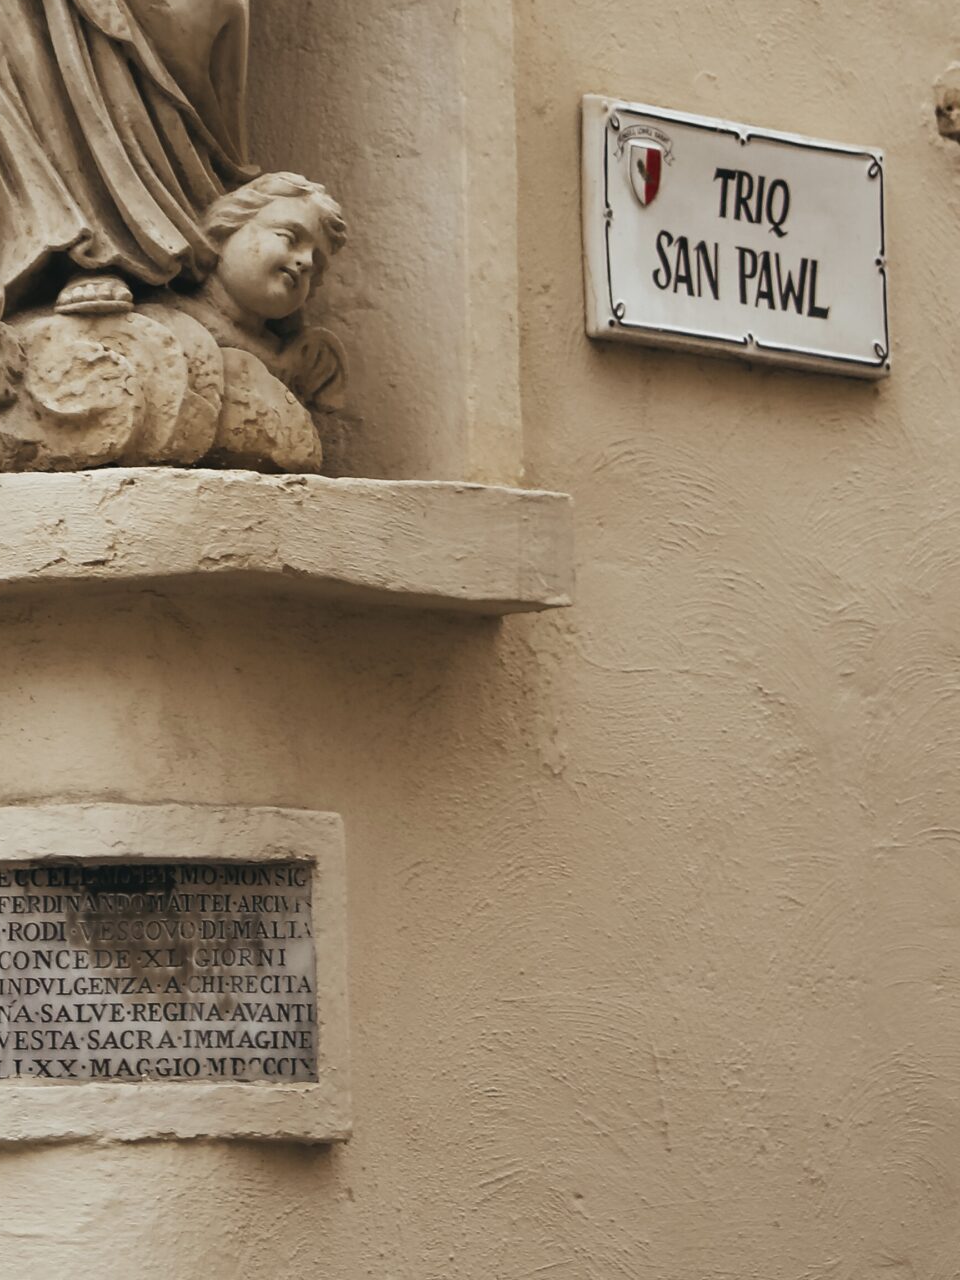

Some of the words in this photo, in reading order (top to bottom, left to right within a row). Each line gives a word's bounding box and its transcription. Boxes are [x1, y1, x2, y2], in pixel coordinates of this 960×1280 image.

[713, 167, 791, 238] TRIQ
[653, 229, 720, 300] SAN
[735, 245, 830, 320] PAWL
[193, 948, 287, 968] GIORNI
